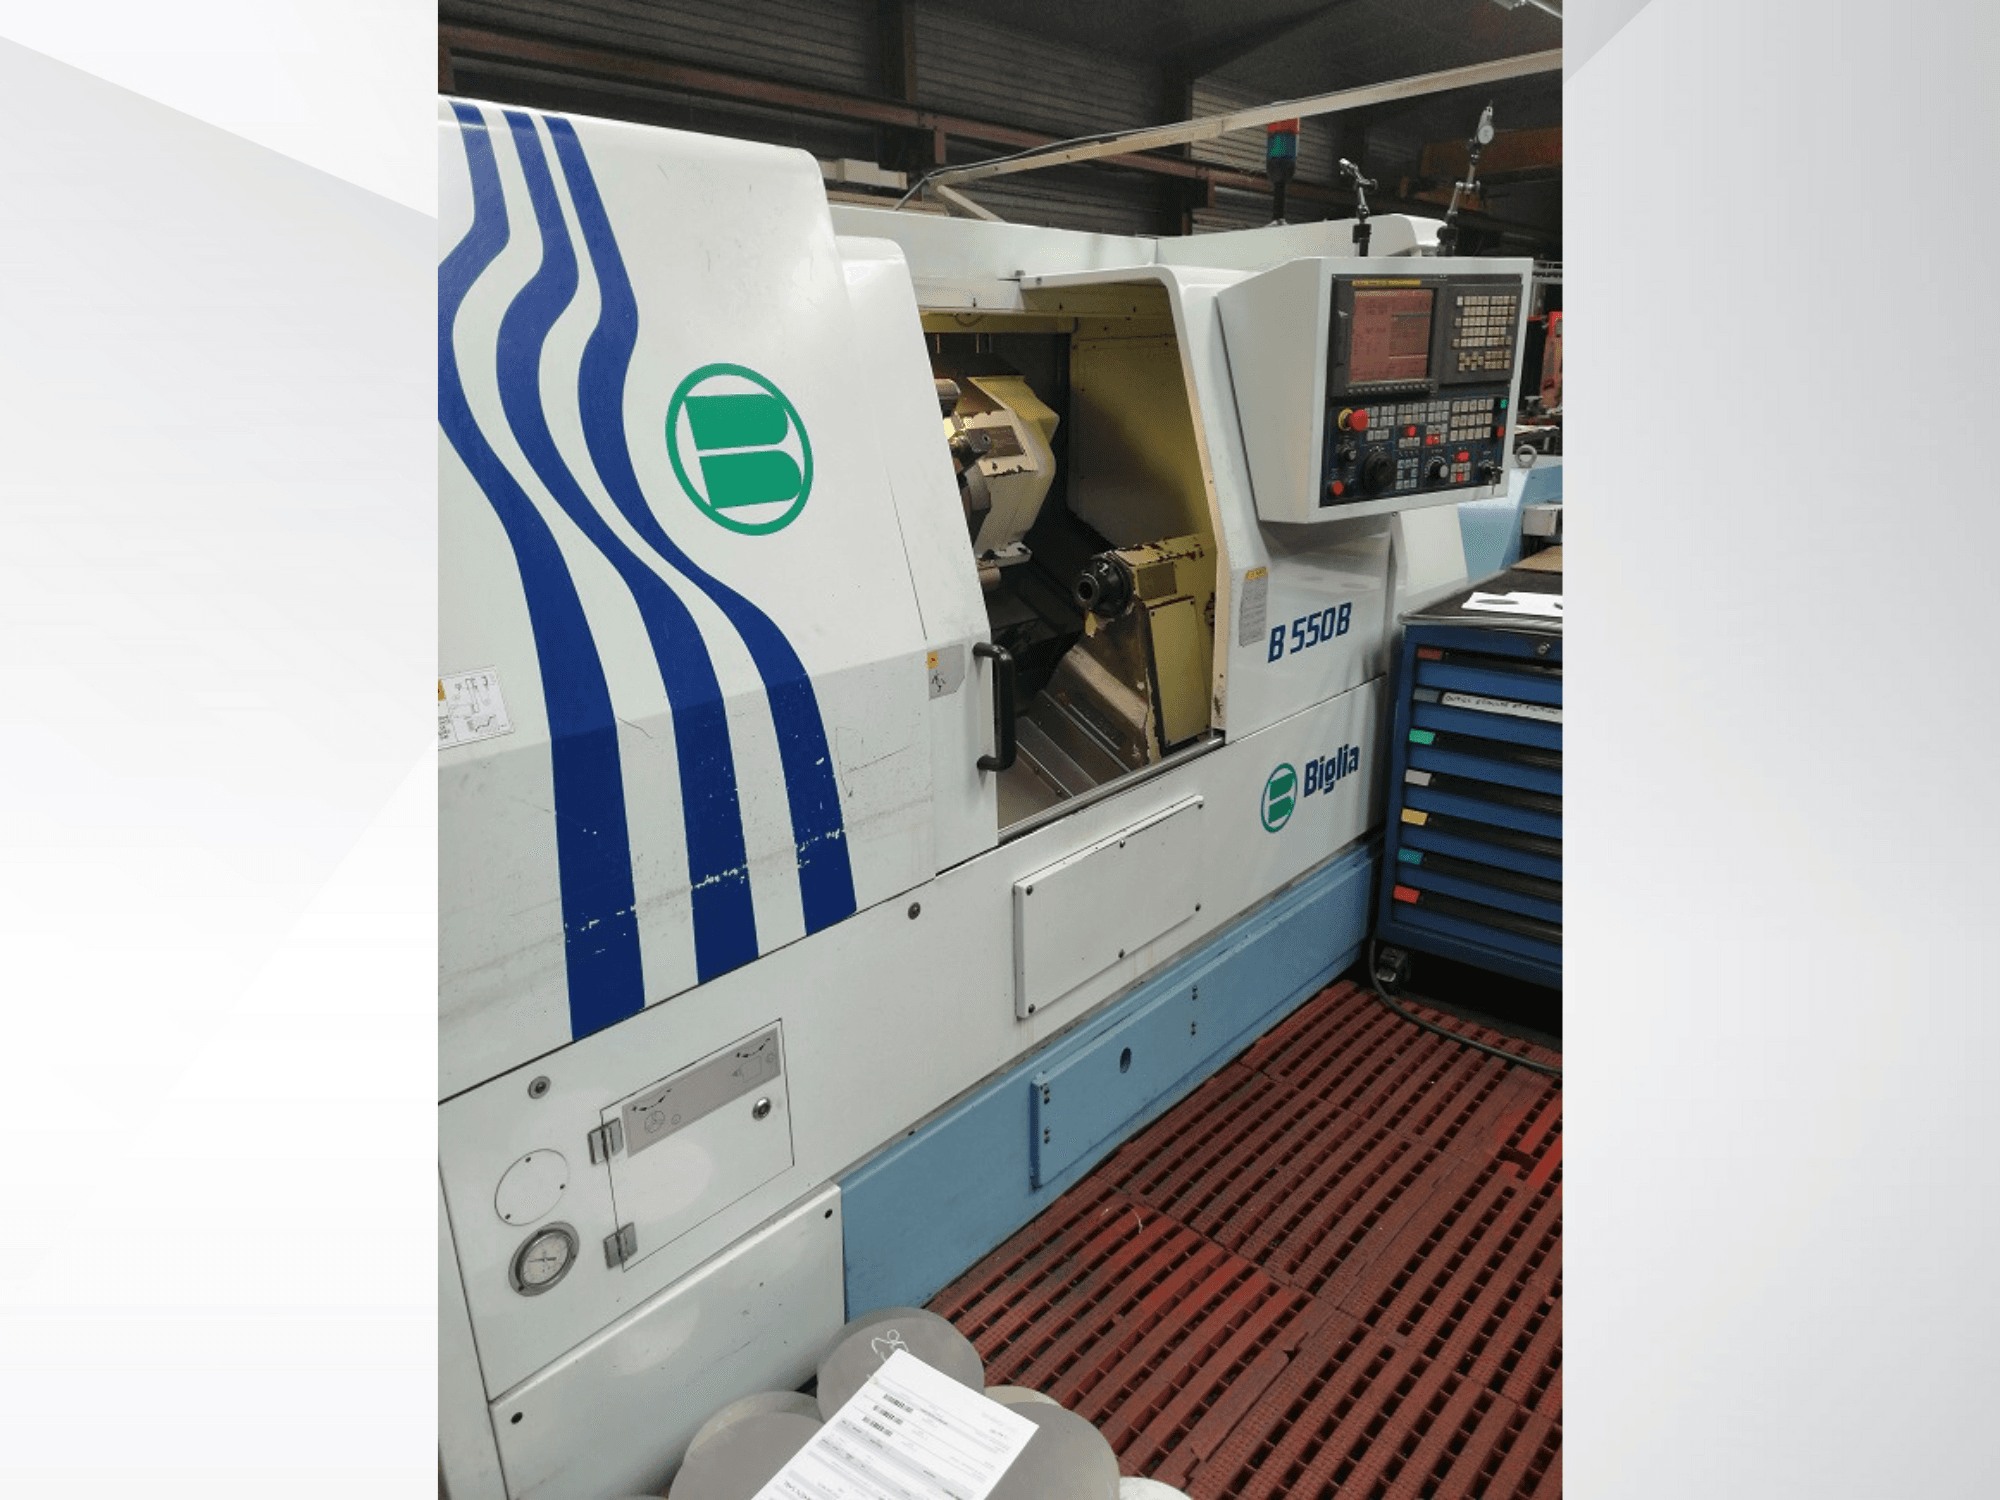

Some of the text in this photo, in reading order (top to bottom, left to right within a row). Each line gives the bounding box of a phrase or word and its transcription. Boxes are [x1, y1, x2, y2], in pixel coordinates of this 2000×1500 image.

[1267, 624, 1286, 664] B
[1289, 602, 1352, 655] 550B
[1303, 743, 1360, 798] Biglia
